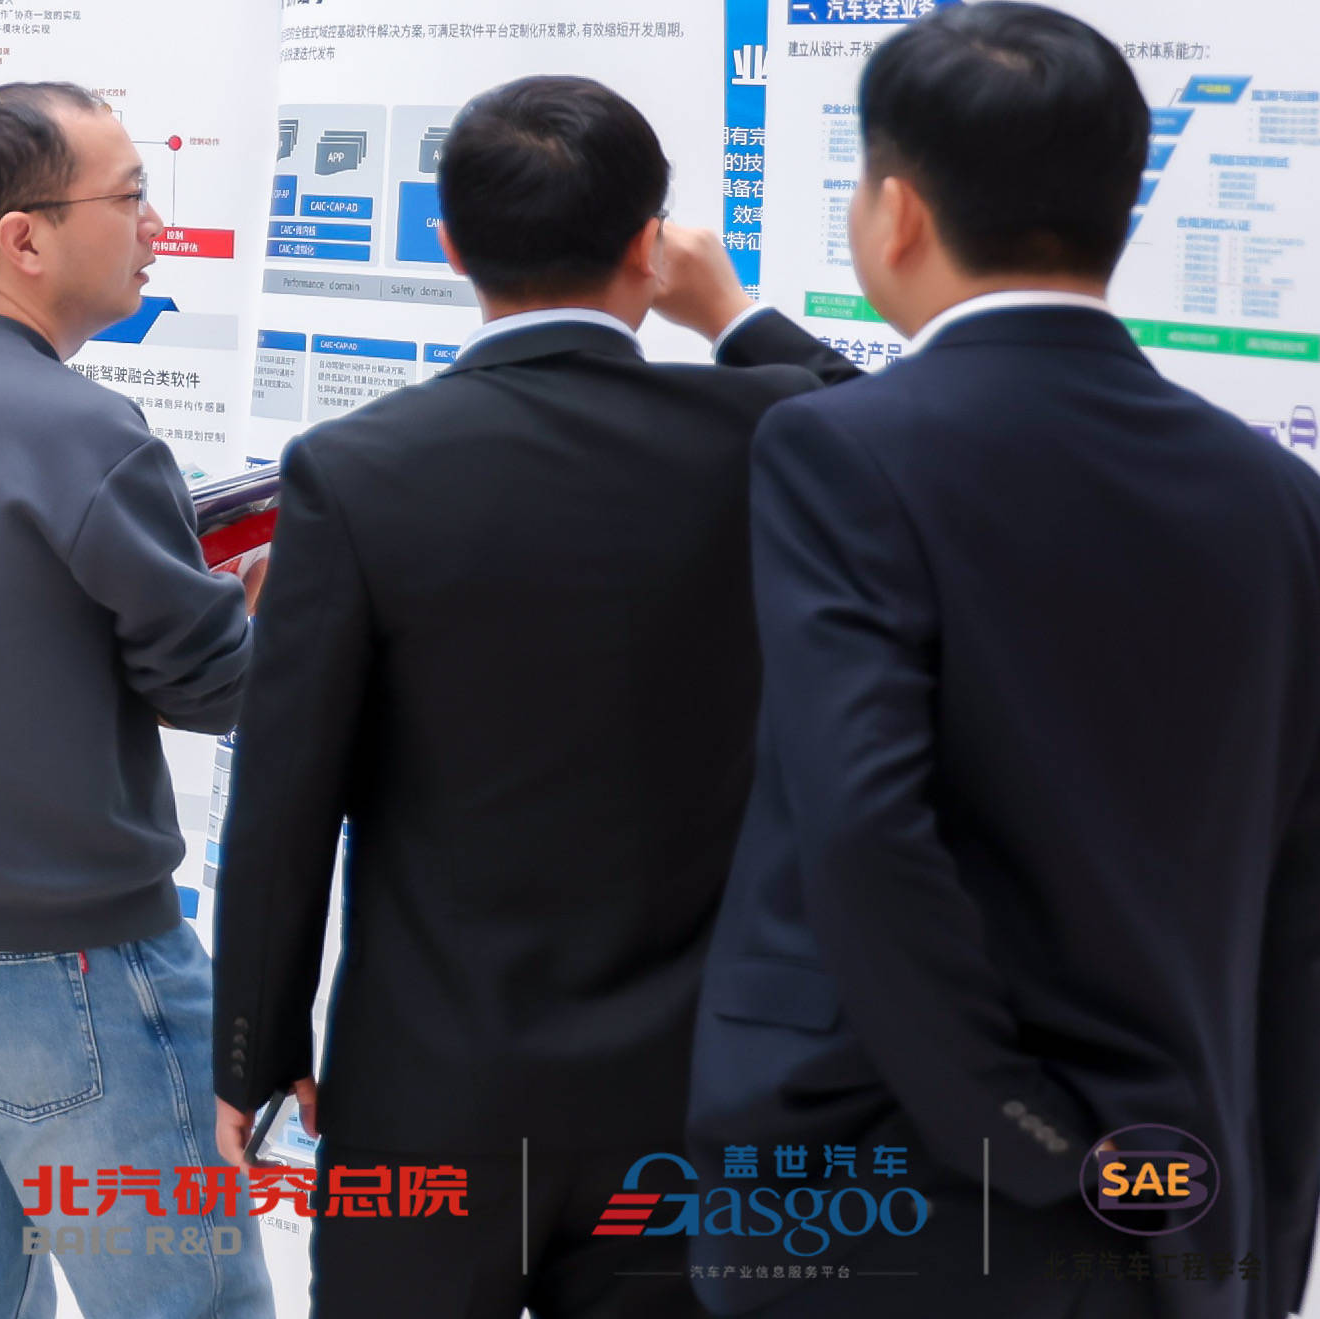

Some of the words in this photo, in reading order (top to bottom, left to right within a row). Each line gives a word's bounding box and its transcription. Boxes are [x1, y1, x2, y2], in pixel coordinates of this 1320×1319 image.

[326, 152, 345, 163] APP
[391, 283, 416, 296] Safety
[420, 286, 453, 299] domain
[64, 362, 201, 390] 智能驾驶融合类软件
